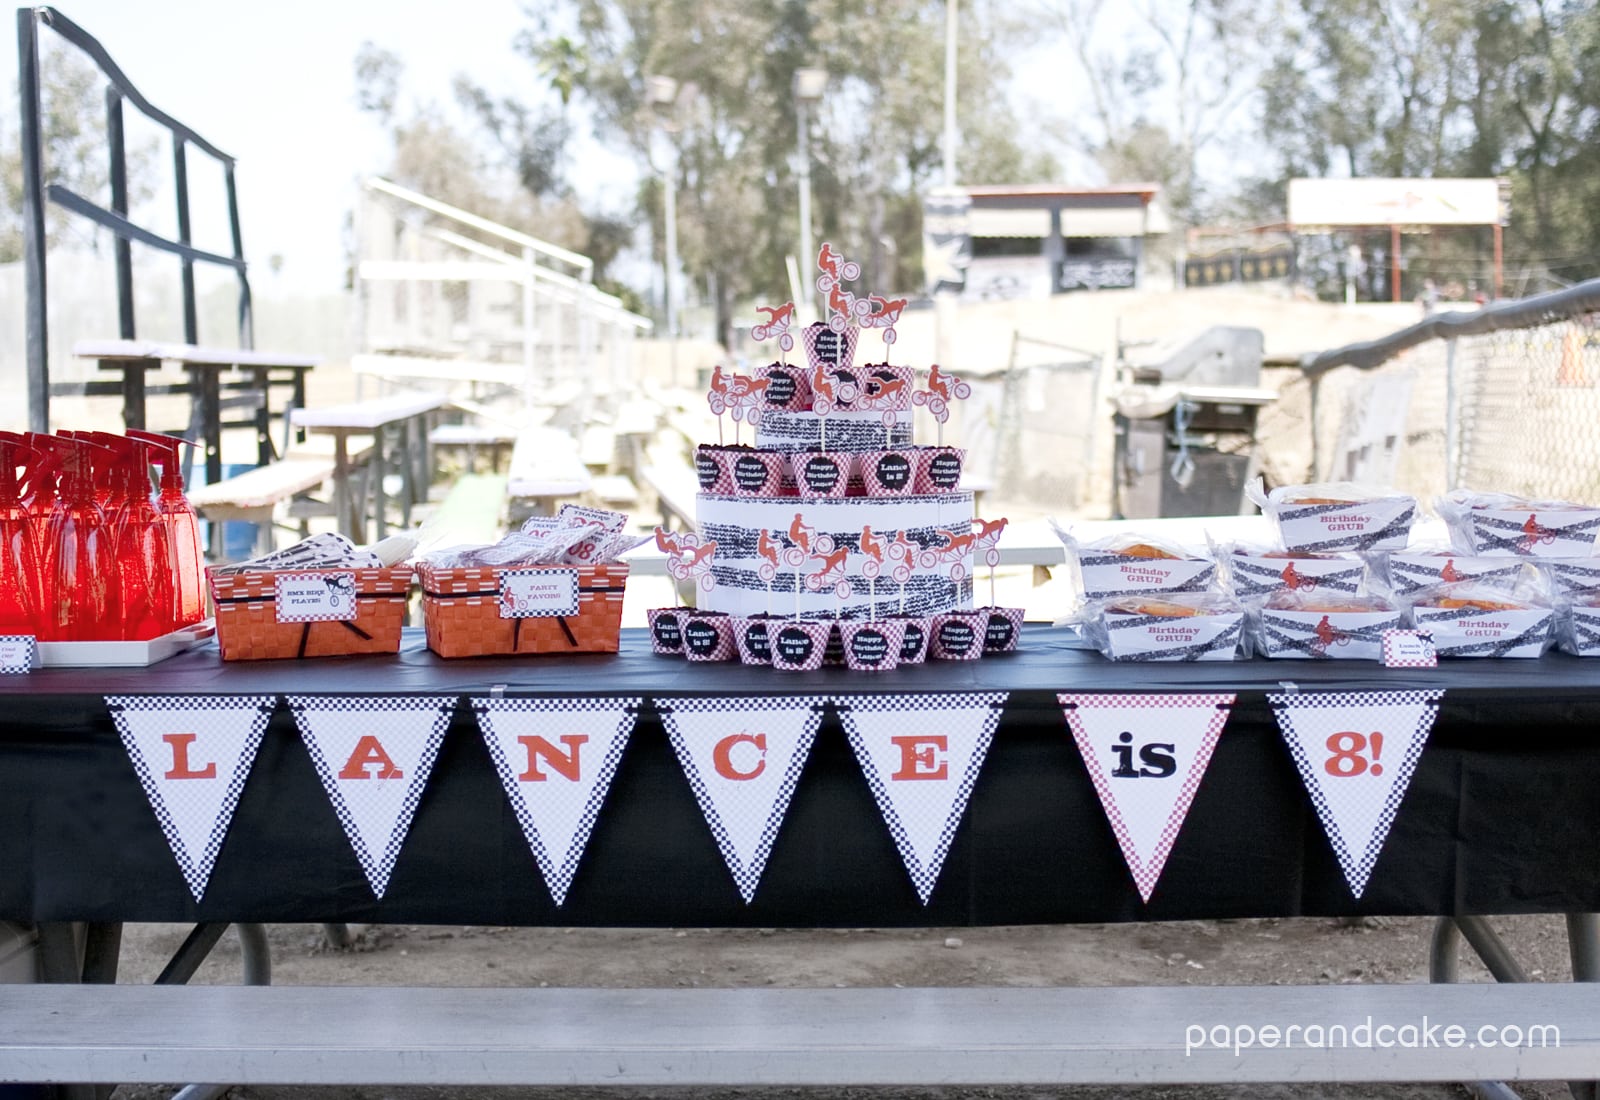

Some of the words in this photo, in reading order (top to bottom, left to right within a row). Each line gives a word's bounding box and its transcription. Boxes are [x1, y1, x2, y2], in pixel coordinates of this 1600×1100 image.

[881, 463, 908, 471] Lance
[1320, 515, 1372, 523] Birthday
[1327, 523, 1364, 531] GRUB
[1119, 565, 1171, 577] Birthday
[1127, 574, 1163, 584] GRUB
[1458, 620, 1510, 629] Birthday
[1147, 627, 1200, 635] Birthday
[1465, 629, 1502, 637] GRUB
[780, 637, 810, 645] Lance
[1111, 731, 1177, 779] is
[1324, 731, 1384, 777] 8!
